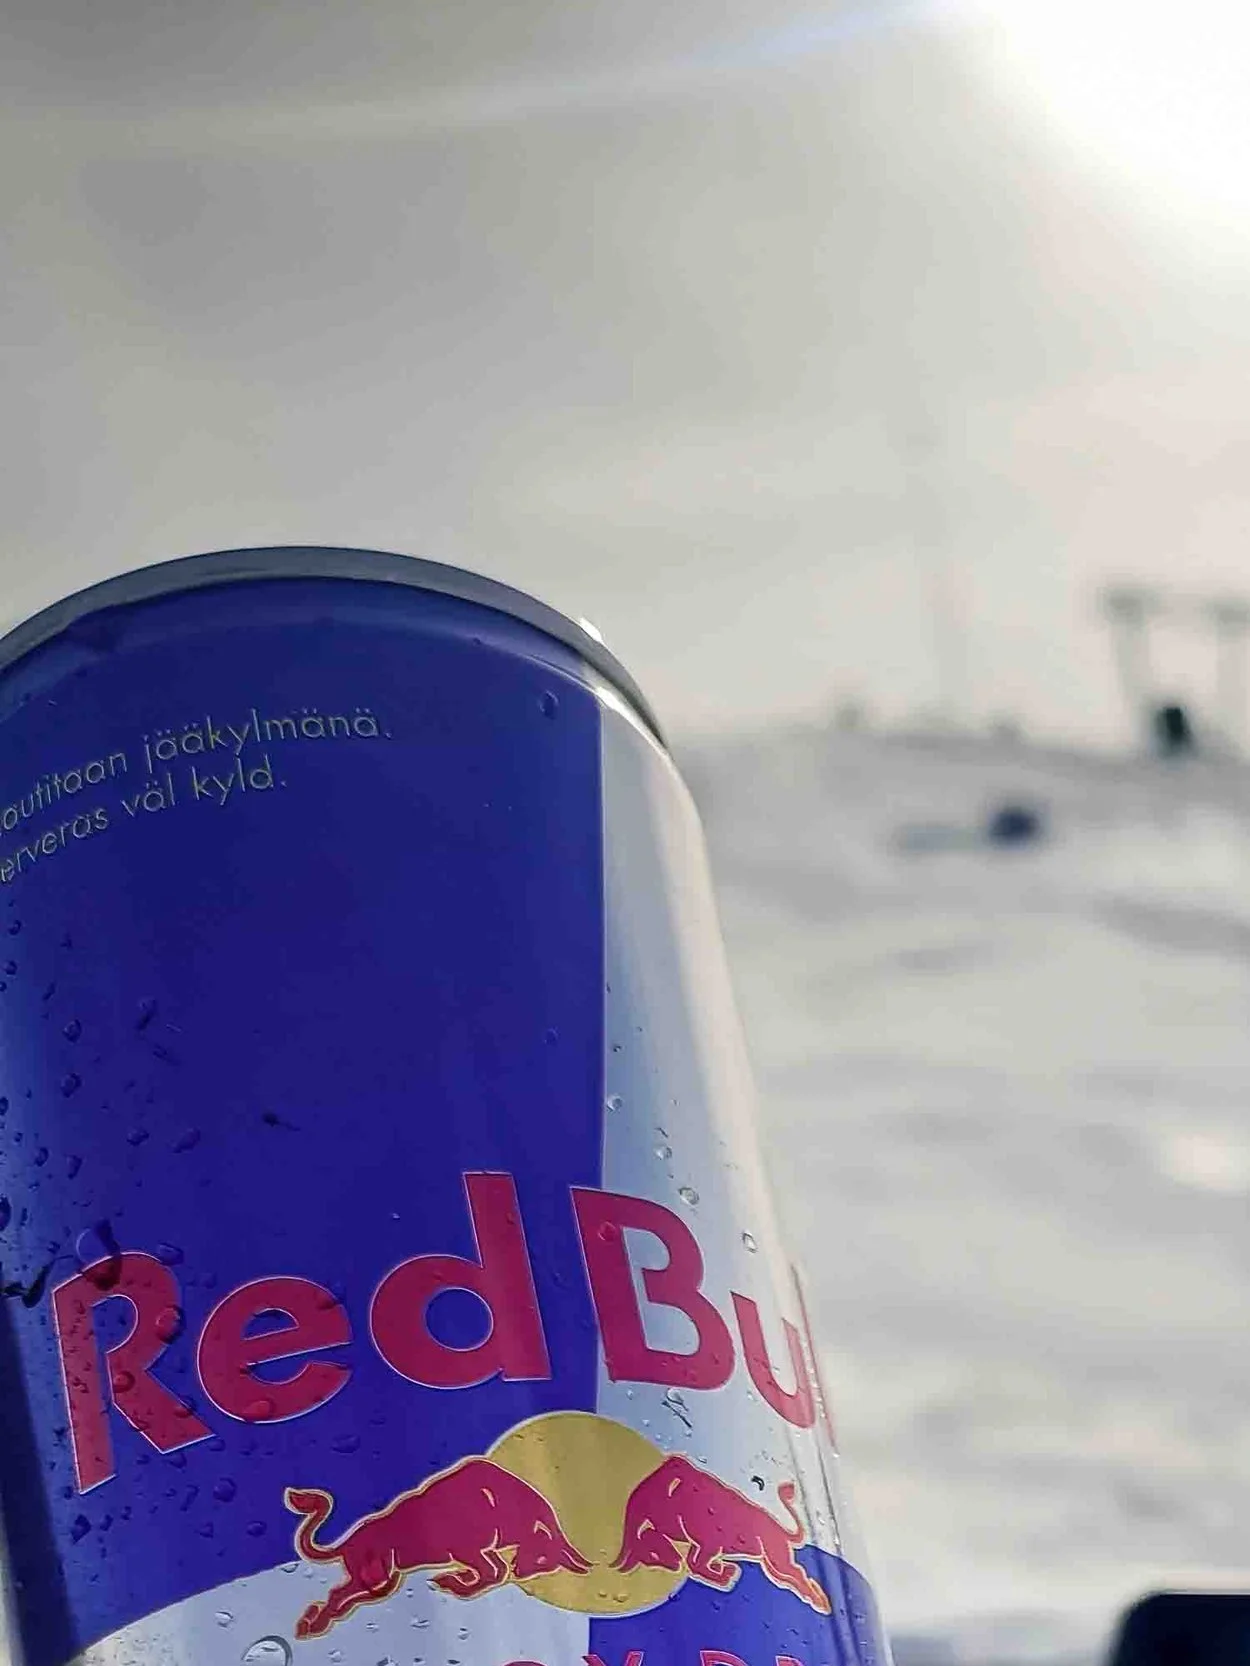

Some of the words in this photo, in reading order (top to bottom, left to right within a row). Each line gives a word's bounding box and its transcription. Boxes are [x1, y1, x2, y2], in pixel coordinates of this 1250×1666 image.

[0, 752, 127, 835] autitaan
[144, 708, 392, 774] jääkylmänä.
[120, 772, 175, 817] väl
[191, 753, 287, 806] kyld.
[52, 1171, 552, 1495] Red
[570, 1185, 838, 1448] Bu
